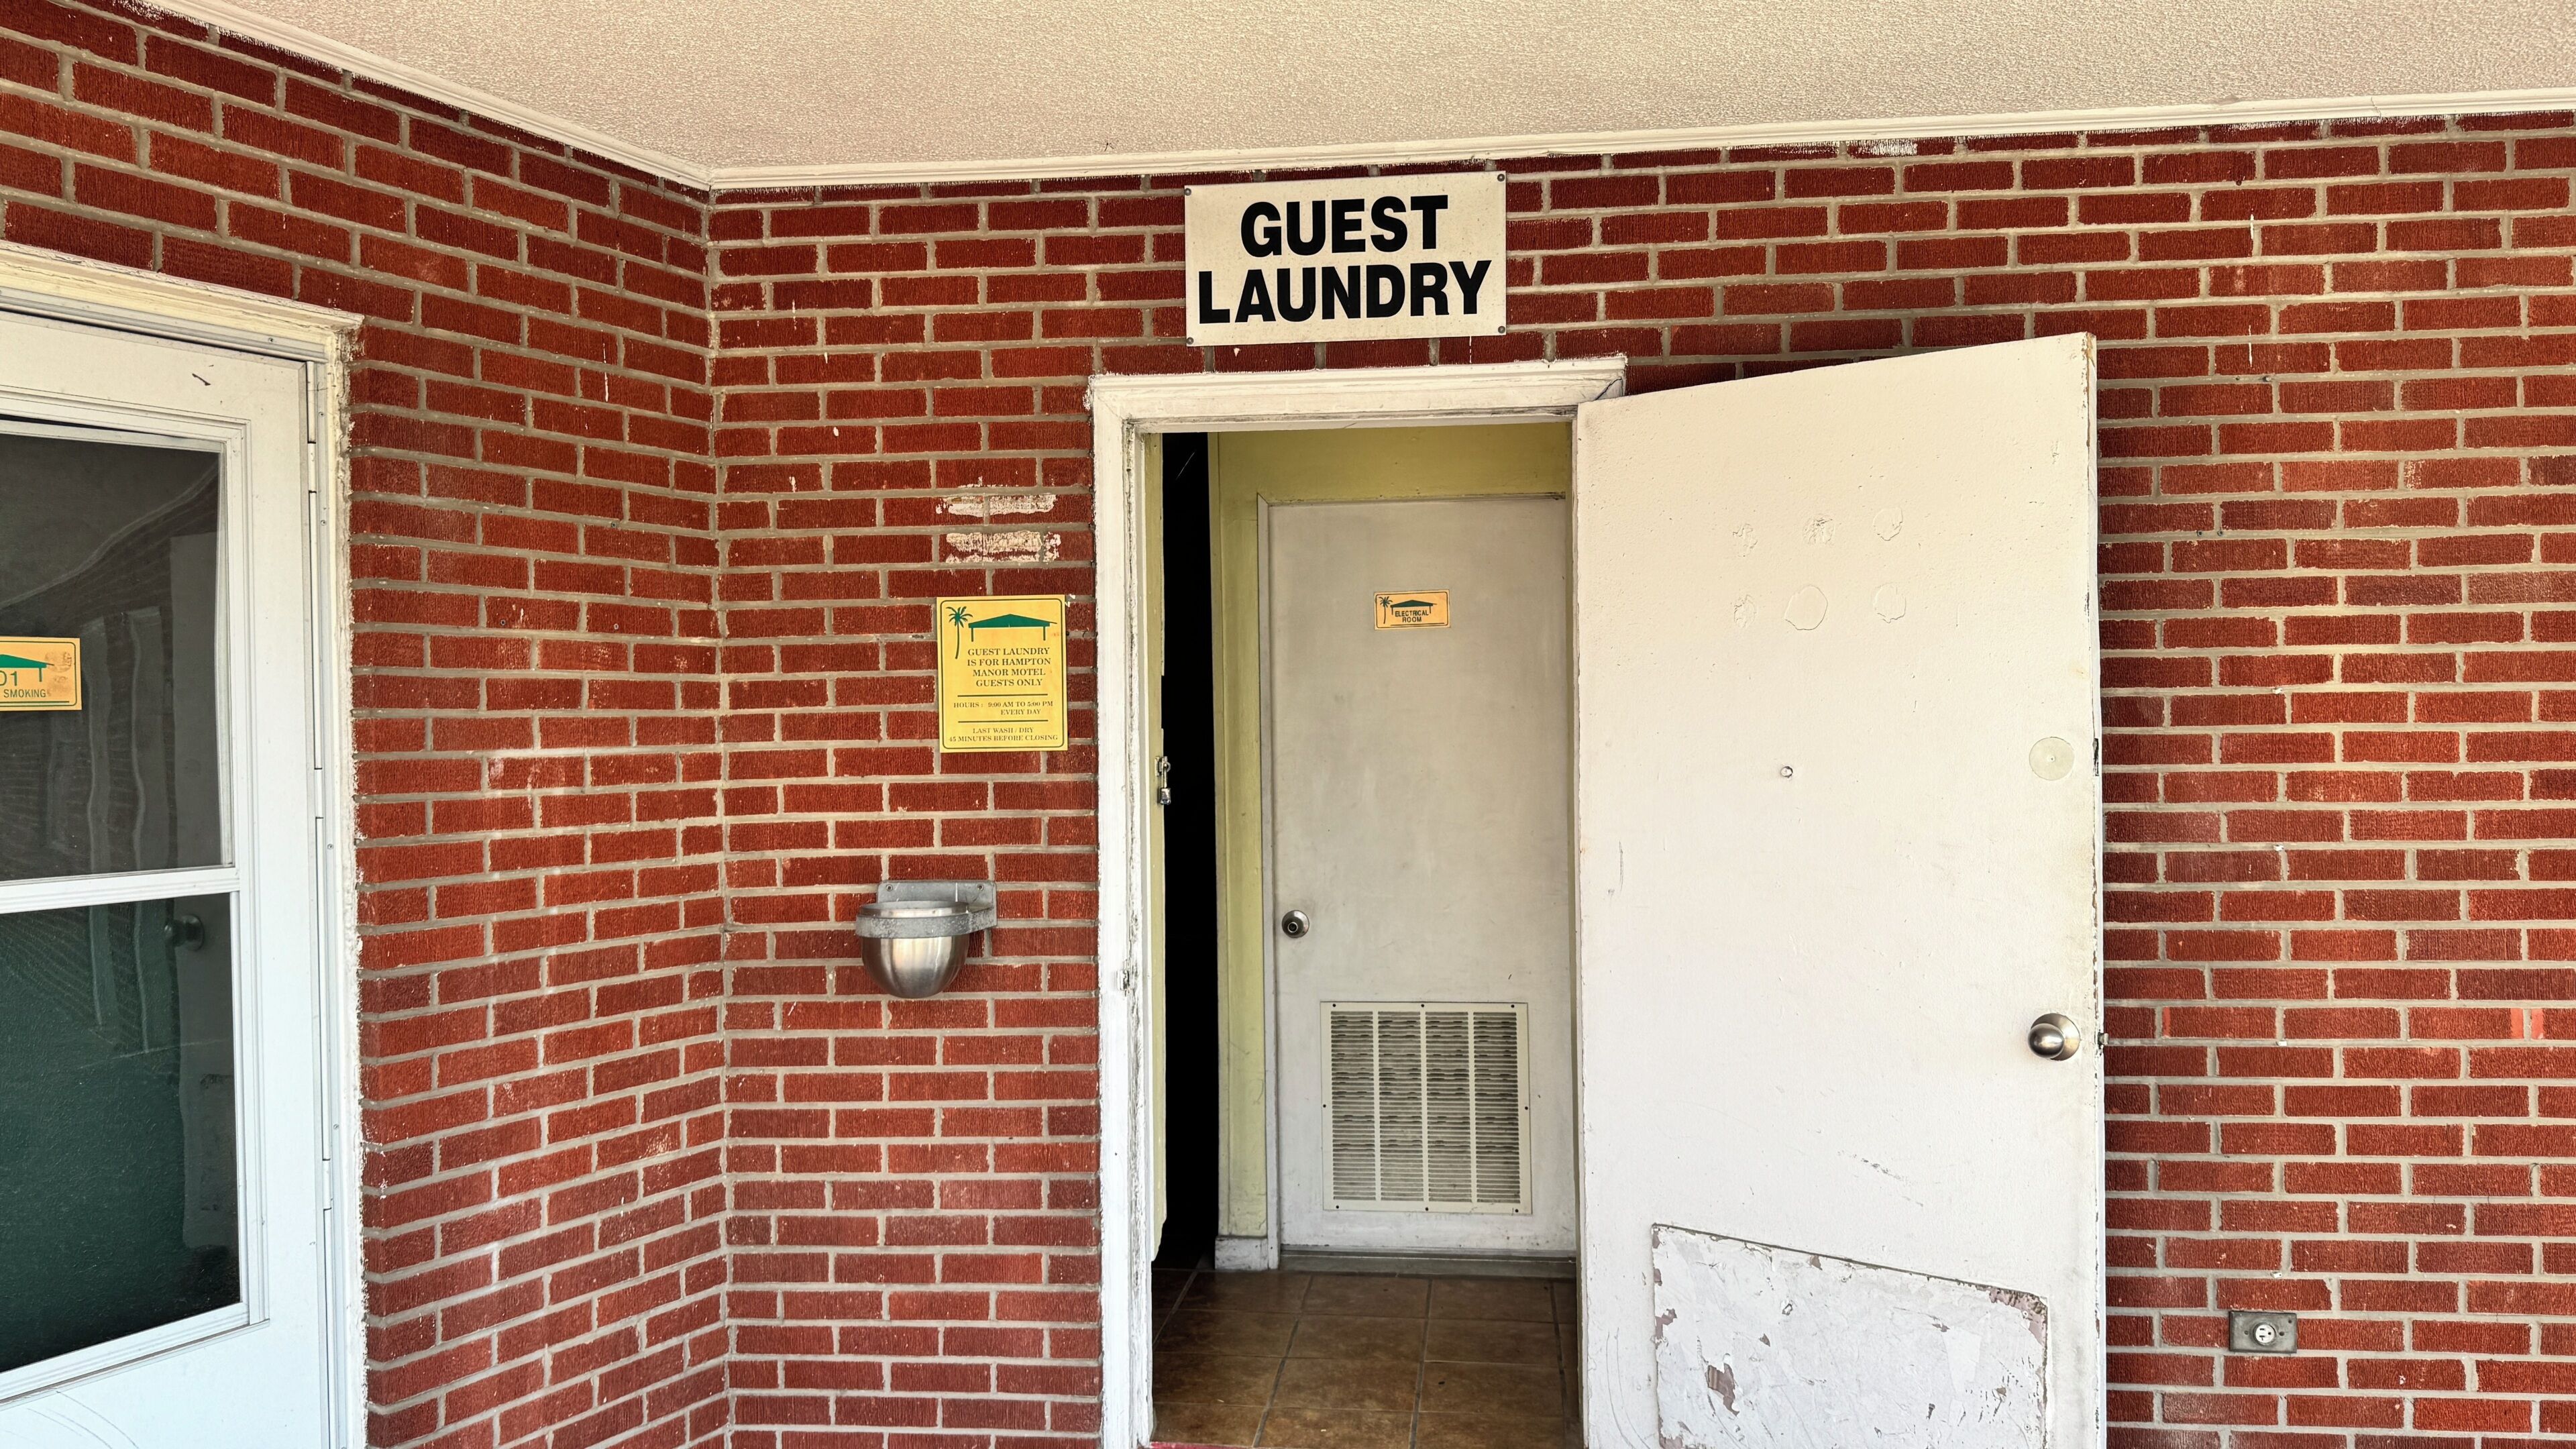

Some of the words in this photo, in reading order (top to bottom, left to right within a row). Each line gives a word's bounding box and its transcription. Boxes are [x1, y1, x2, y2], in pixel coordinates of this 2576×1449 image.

[1241, 195, 1448, 258] GUEST
[1199, 260, 1492, 324] LAUNDRY
[1003, 647, 1050, 655] LAUNDRY
[1017, 678, 1042, 686] ONLY
[3, 689, 46, 698] SMOKING
